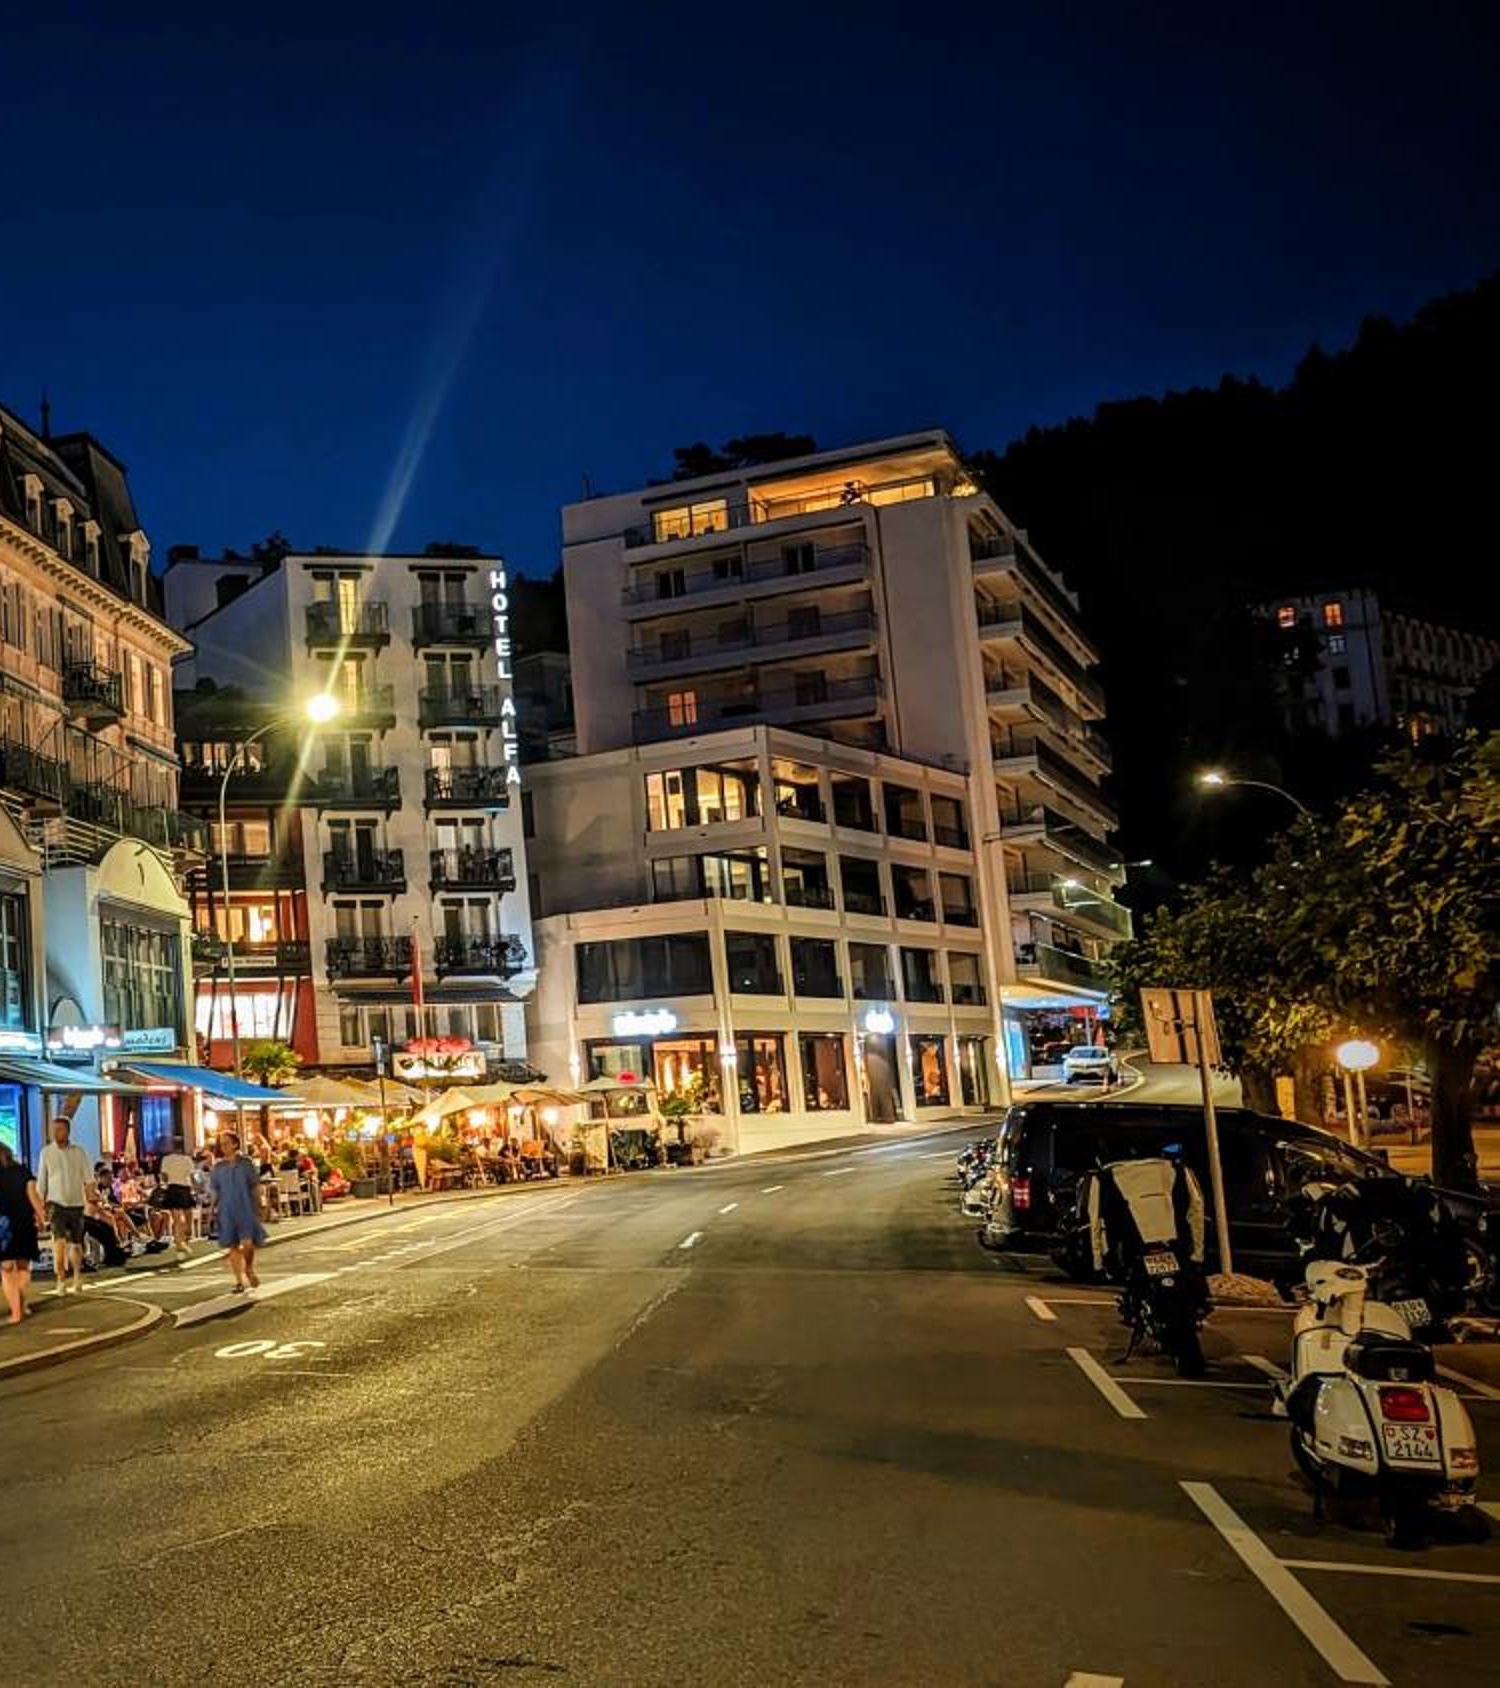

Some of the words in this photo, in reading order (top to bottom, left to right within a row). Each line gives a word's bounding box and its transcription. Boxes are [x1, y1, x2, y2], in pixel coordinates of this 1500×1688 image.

[490, 571, 512, 679] HOTEL
[501, 698, 521, 784] ALFA
[214, 1340, 325, 1359] 30
